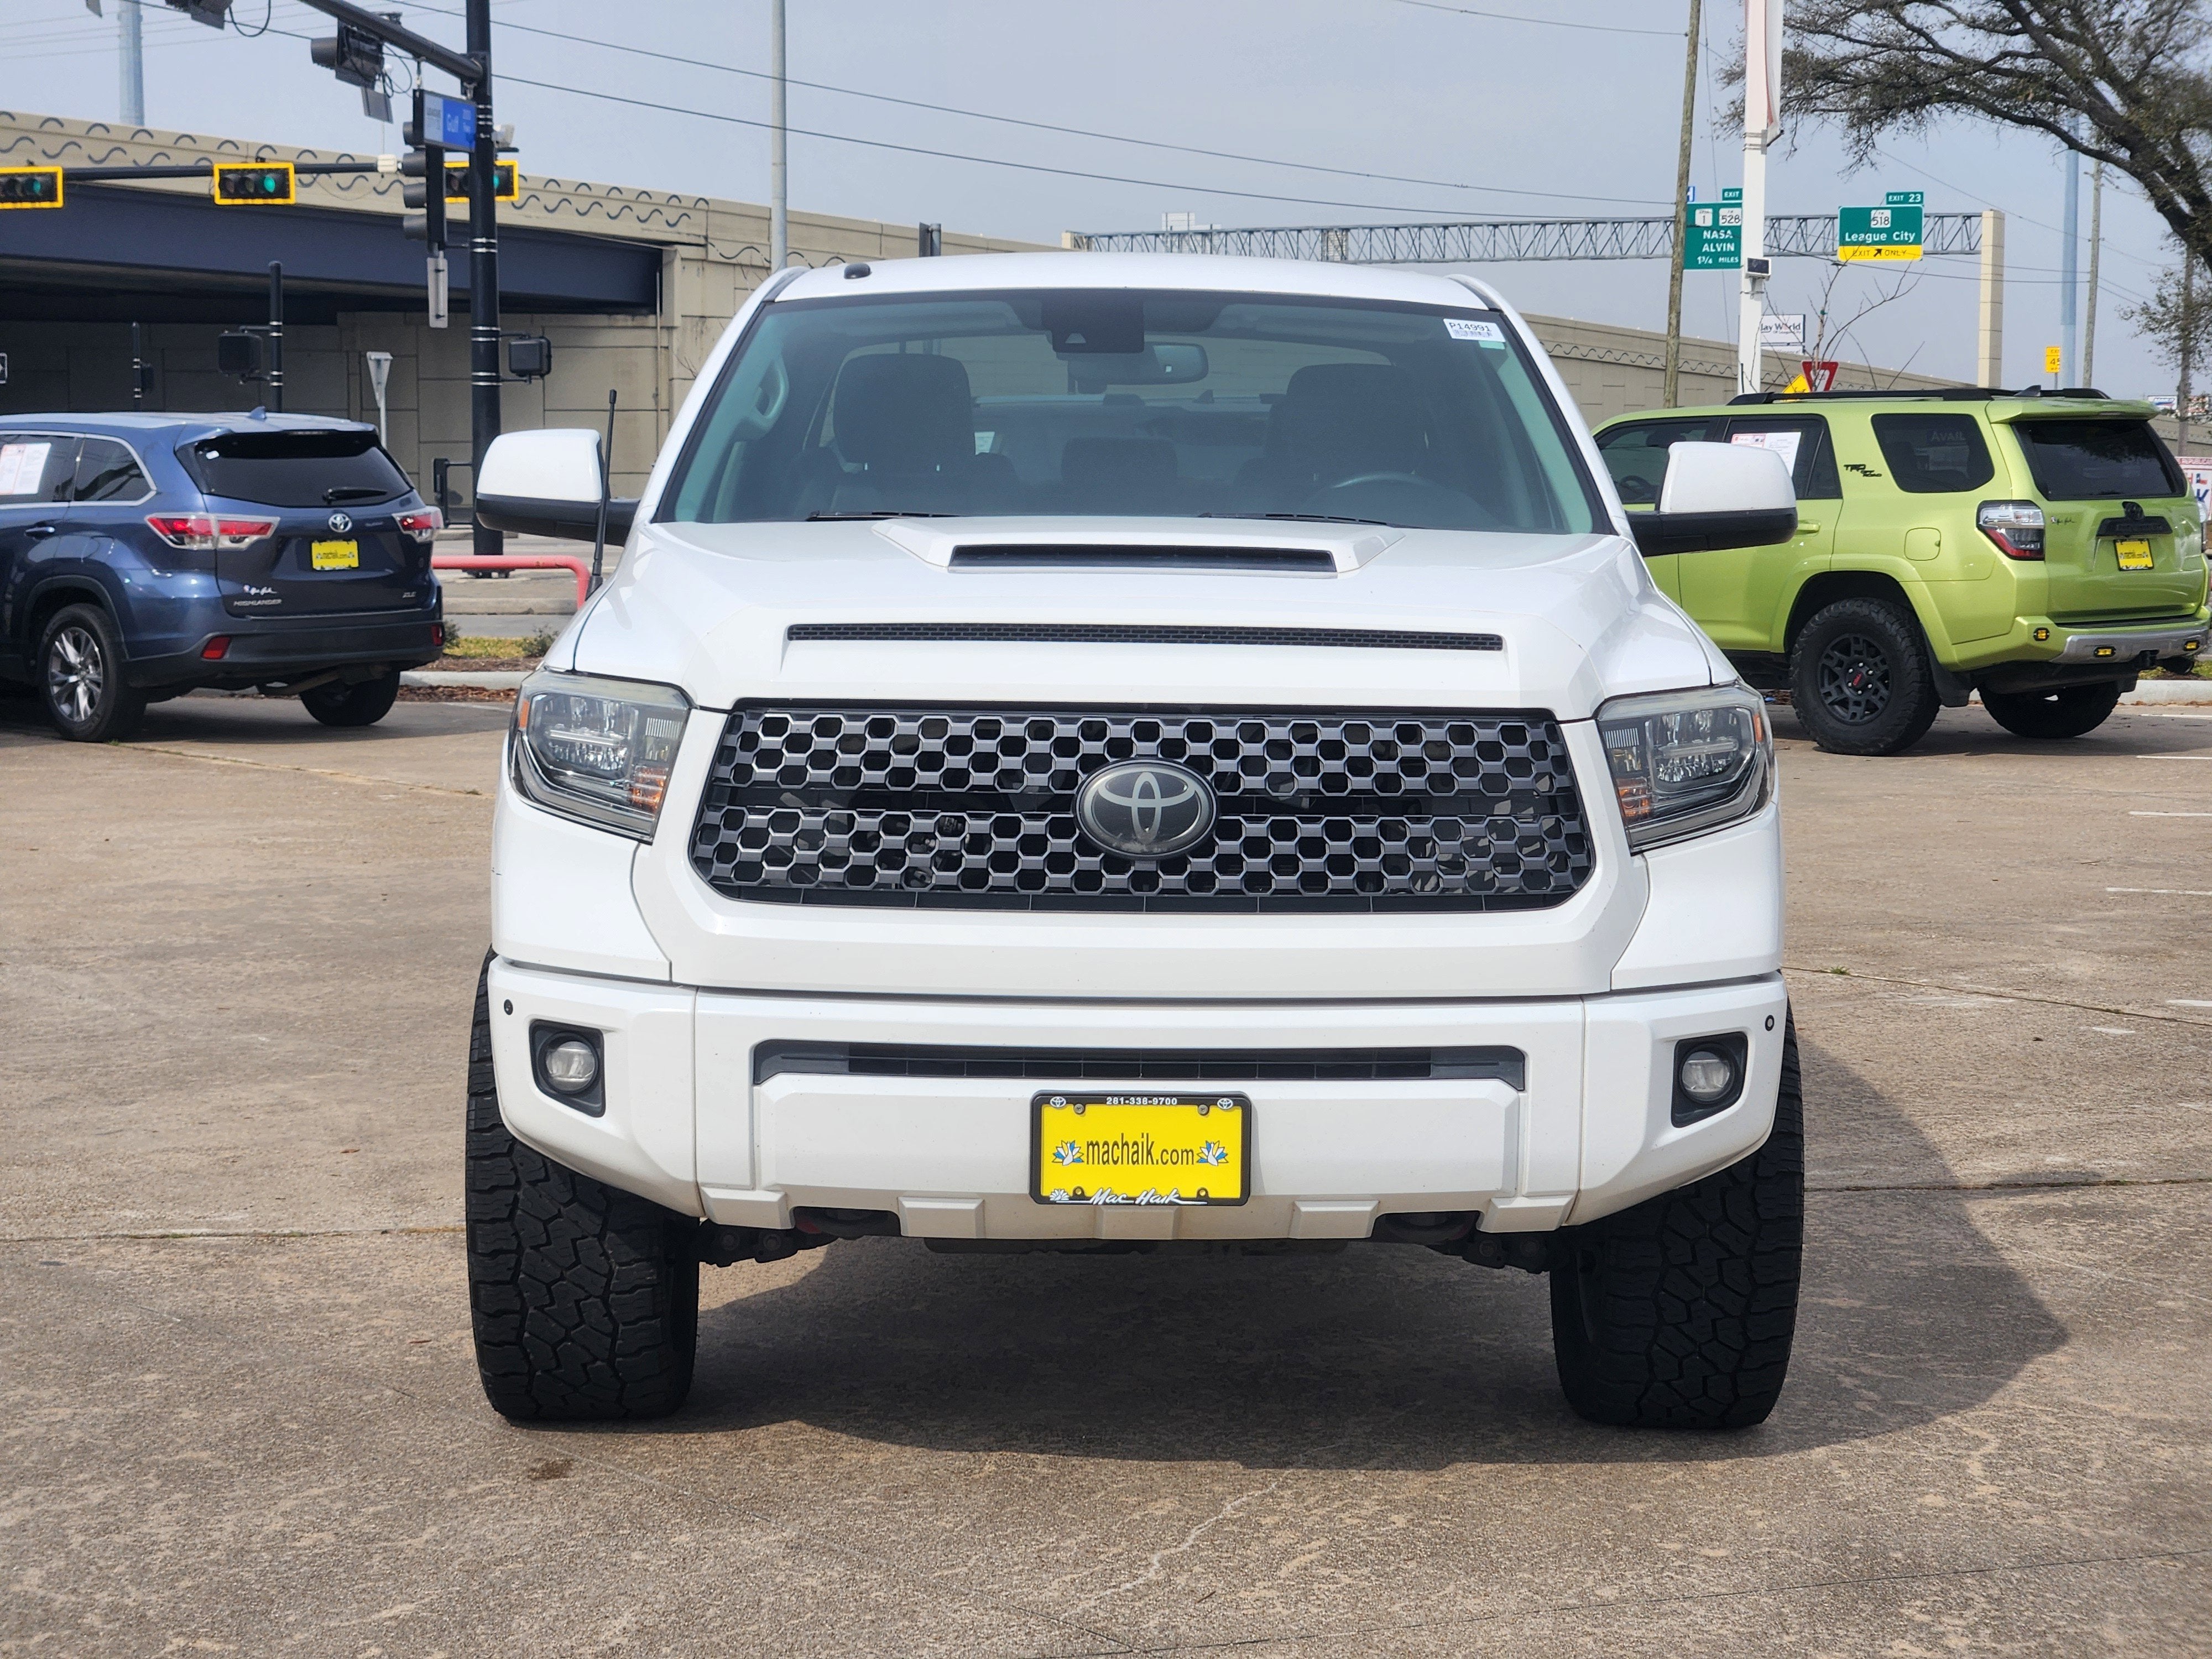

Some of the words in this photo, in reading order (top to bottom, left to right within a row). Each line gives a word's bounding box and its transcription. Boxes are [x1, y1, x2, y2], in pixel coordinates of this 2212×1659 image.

[1908, 194, 1921, 202] 23
[1721, 214, 1740, 224] 528
[1872, 216, 1890, 226] 518
[1703, 230, 1733, 239] NASA
[1845, 232, 1887, 243] League
[1892, 231, 1916, 243] City
[1702, 243, 1735, 252] ALVIN
[1449, 322, 1492, 331] P14991
[1761, 323, 1773, 333] lay
[1106, 1097, 1177, 1105] 281-338-9700
[1086, 1132, 1194, 1165] machaik.com
[1091, 1188, 1133, 1205] Mac
[1135, 1188, 1181, 1206] Haik
